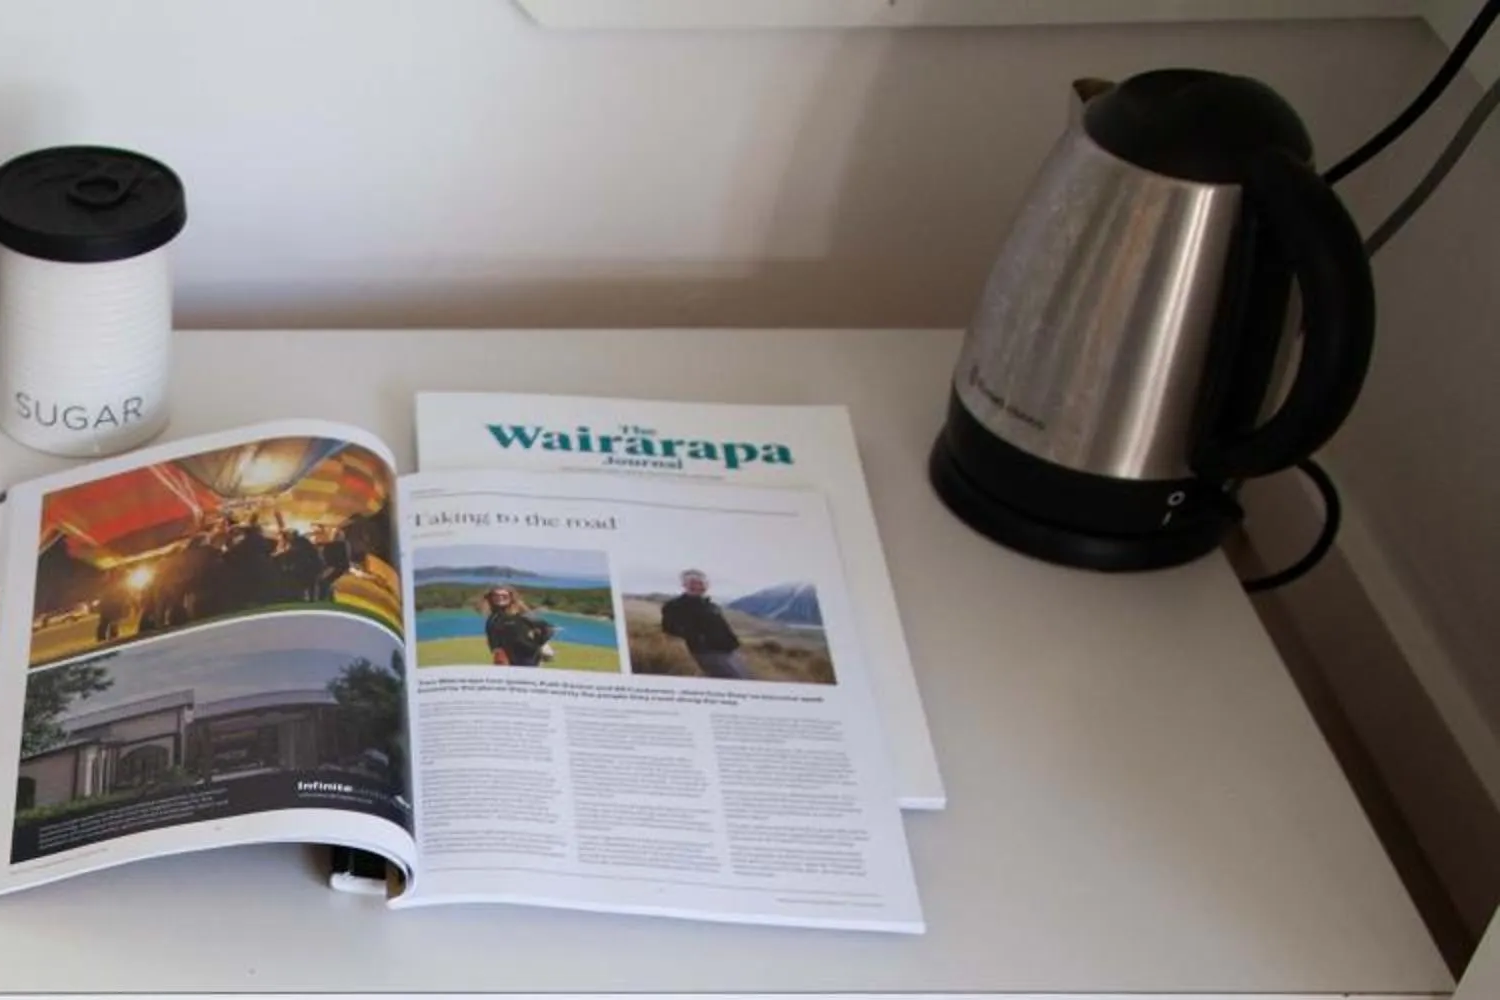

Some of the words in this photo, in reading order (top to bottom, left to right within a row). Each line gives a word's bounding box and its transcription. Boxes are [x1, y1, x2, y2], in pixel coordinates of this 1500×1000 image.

[15, 392, 144, 431] SUGAR
[485, 423, 795, 470] Wairarapa
[601, 456, 683, 470] Journal
[414, 511, 491, 528] Taking
[496, 512, 520, 525] to
[525, 512, 559, 528] the
[565, 512, 618, 530] road
[297, 781, 354, 792] Infinite
